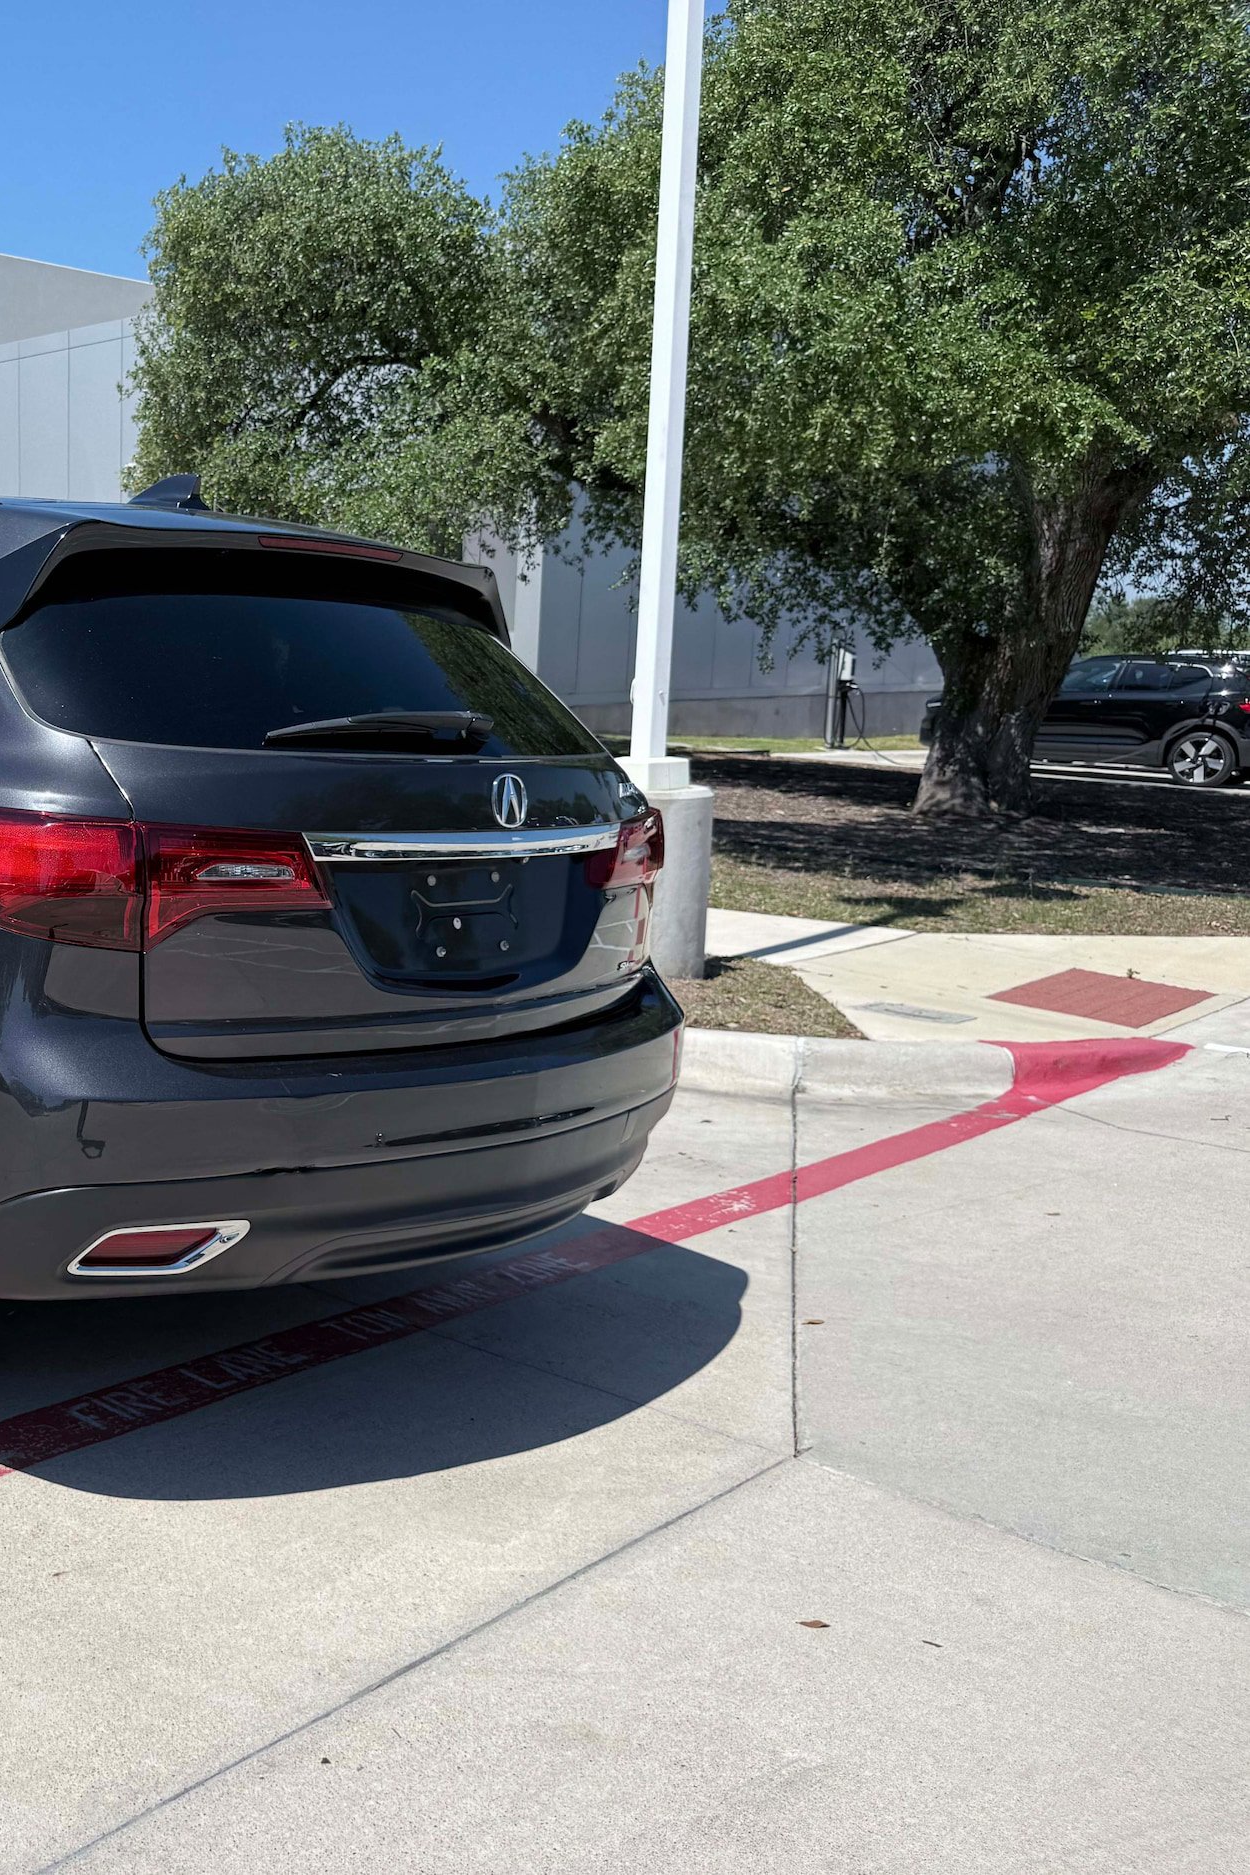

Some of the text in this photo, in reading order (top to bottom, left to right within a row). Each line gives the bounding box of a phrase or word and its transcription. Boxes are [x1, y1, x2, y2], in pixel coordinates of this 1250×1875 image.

[66, 1380, 184, 1431] FIRE
[178, 1340, 308, 1390] LANE
[317, 1306, 409, 1341] TOW
